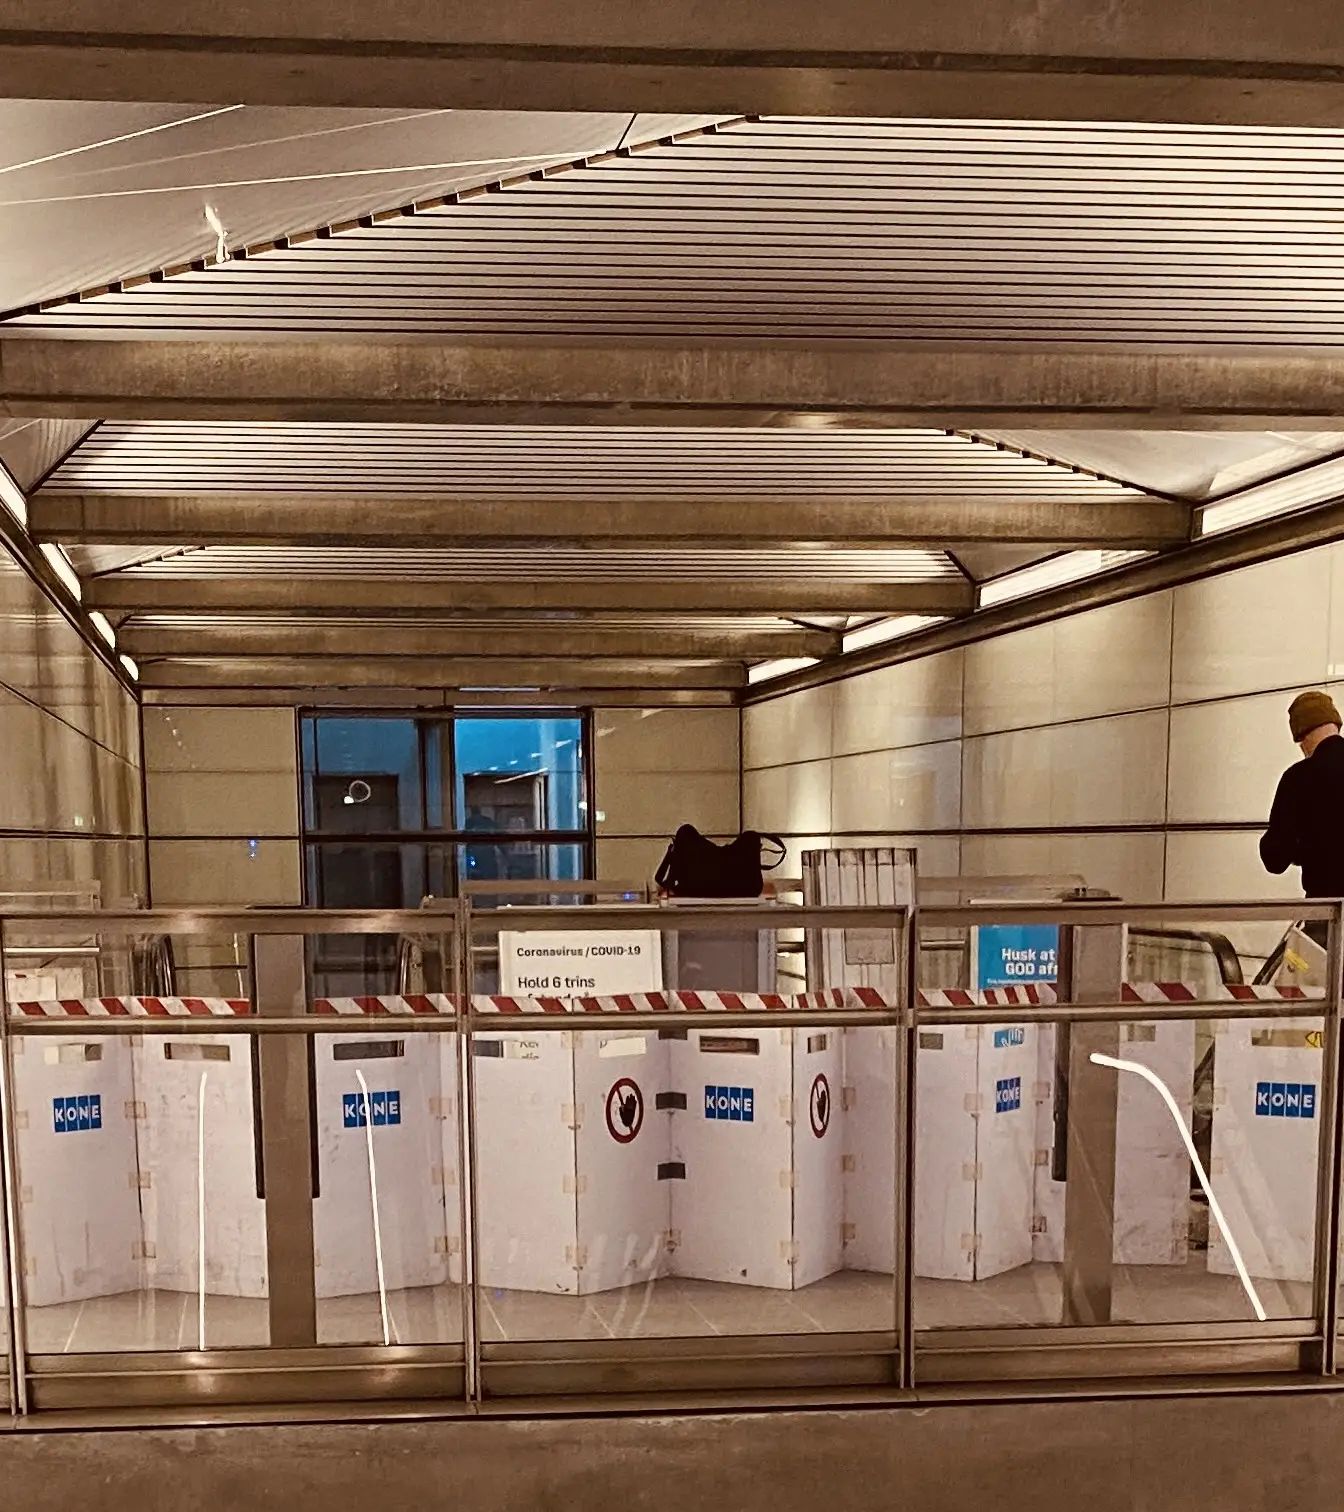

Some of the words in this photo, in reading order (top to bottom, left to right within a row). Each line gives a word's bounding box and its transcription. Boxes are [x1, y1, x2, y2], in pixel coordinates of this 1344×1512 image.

[517, 945, 583, 957] Coronavirus
[1002, 948, 1036, 961] Husk
[1039, 949, 1055, 961] at
[1006, 962, 1035, 976] GOD
[518, 976, 549, 989] Hold
[553, 976, 561, 989] 6
[565, 975, 595, 989] trins
[996, 1086, 1020, 1104] KONE
[1257, 1091, 1313, 1109] KONE
[705, 1095, 752, 1113] KONE
[55, 1104, 99, 1123] KONE
